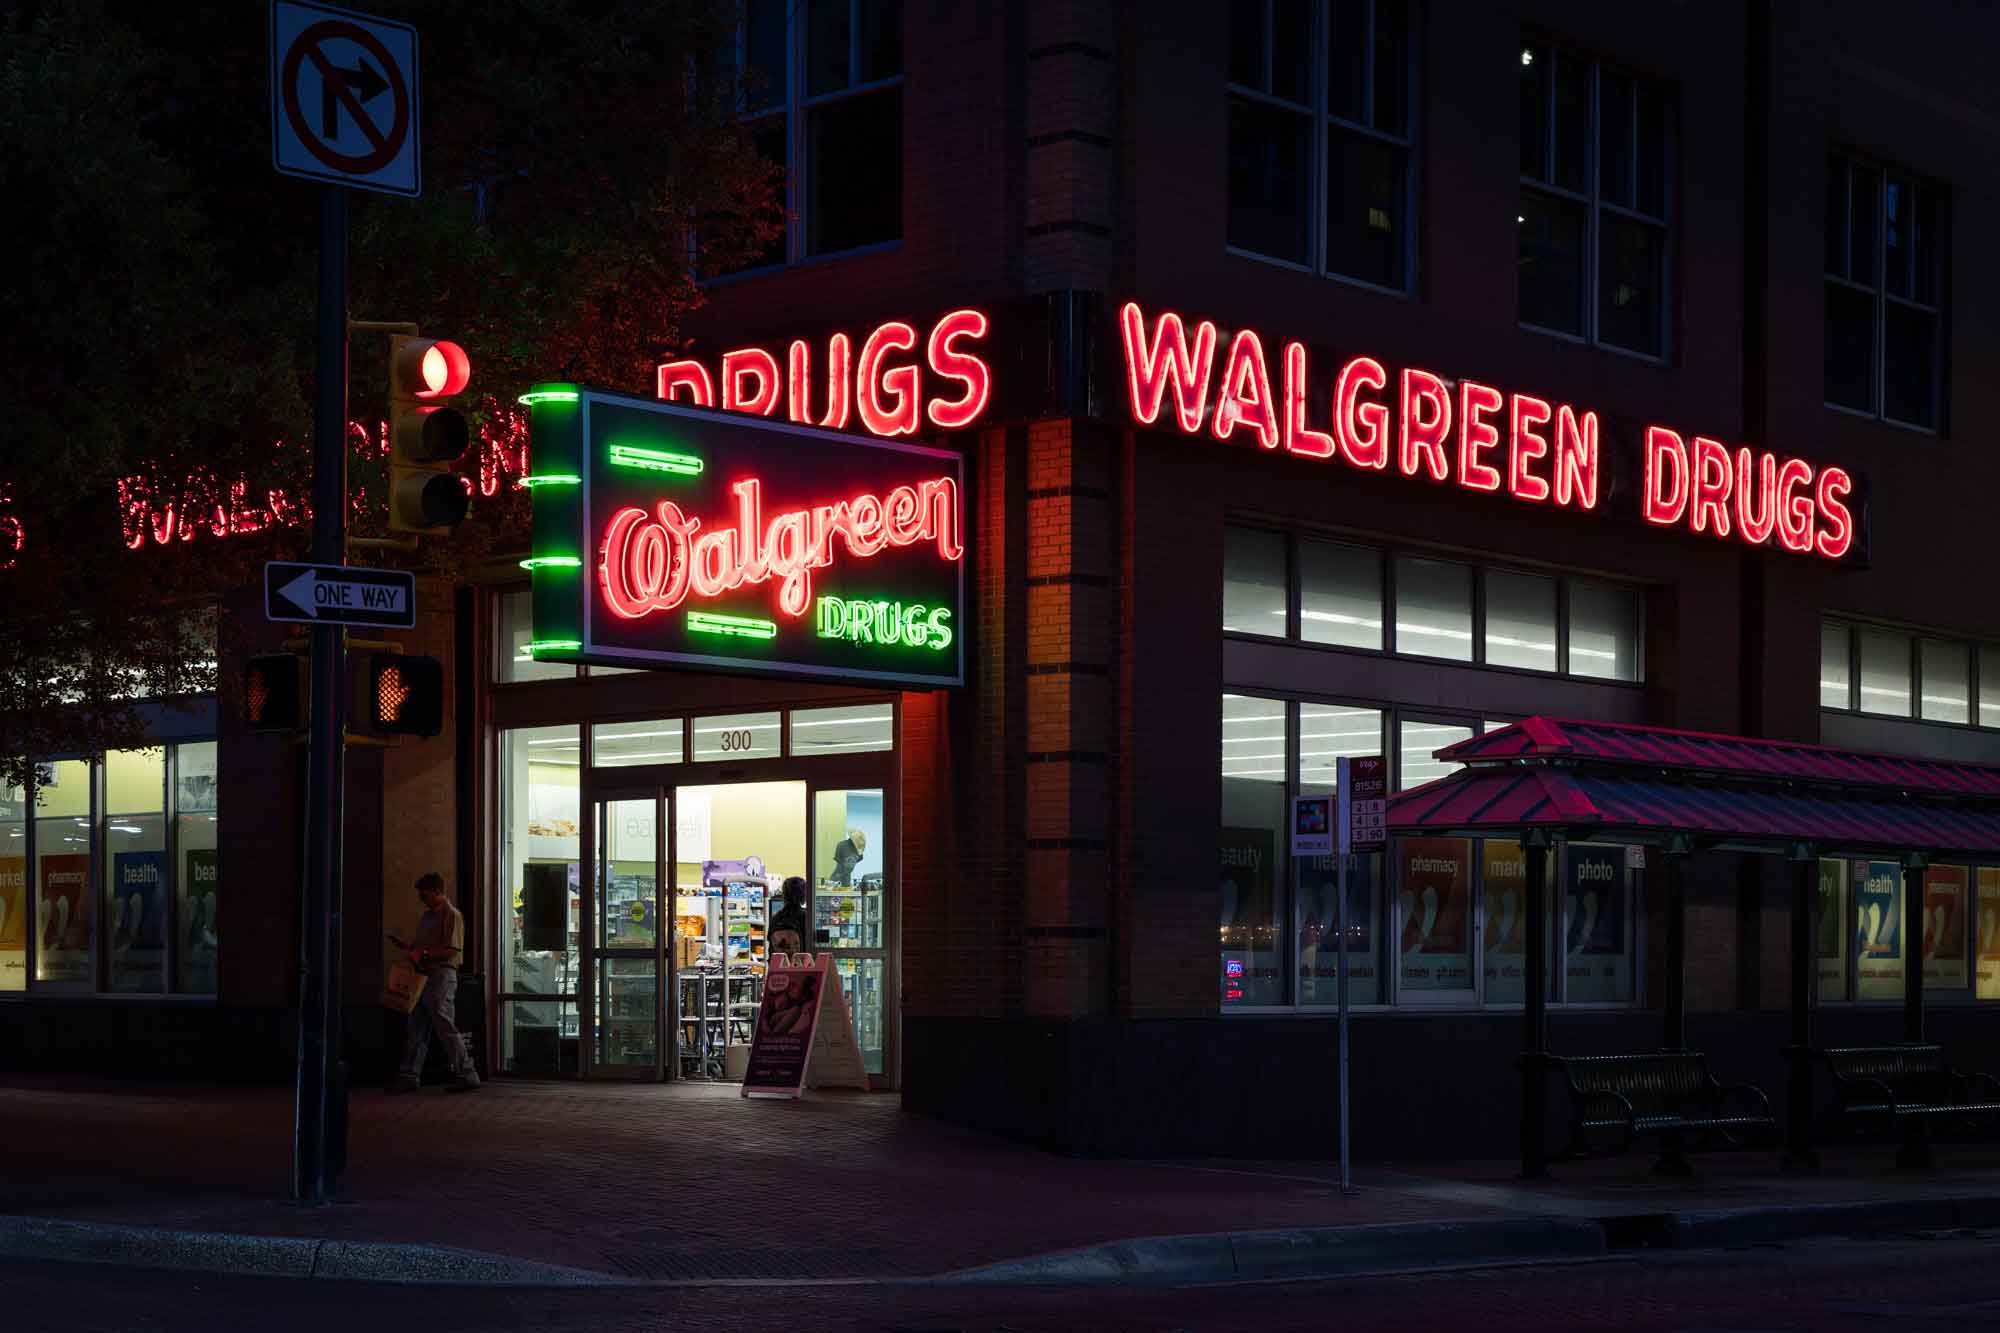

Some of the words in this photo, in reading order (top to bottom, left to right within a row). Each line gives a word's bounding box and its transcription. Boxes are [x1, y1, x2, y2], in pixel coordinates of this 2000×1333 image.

[1122, 302, 1599, 510] WALGREEN
[1645, 426, 1852, 558] DRUGS
[600, 476, 964, 618] Walgreen
[314, 583, 352, 606] ONE
[361, 585, 399, 609] WAY
[816, 596, 952, 650] DRUGS
[721, 730, 752, 751] 300
[1218, 842, 1264, 873] eauty
[1410, 855, 1460, 877] pharmacy
[1489, 858, 1527, 877] mark
[0, 870, 25, 886] rket
[123, 863, 159, 885] health
[194, 861, 217, 882] bea
[1577, 857, 1614, 884] photo
[1864, 873, 1894, 895] health
